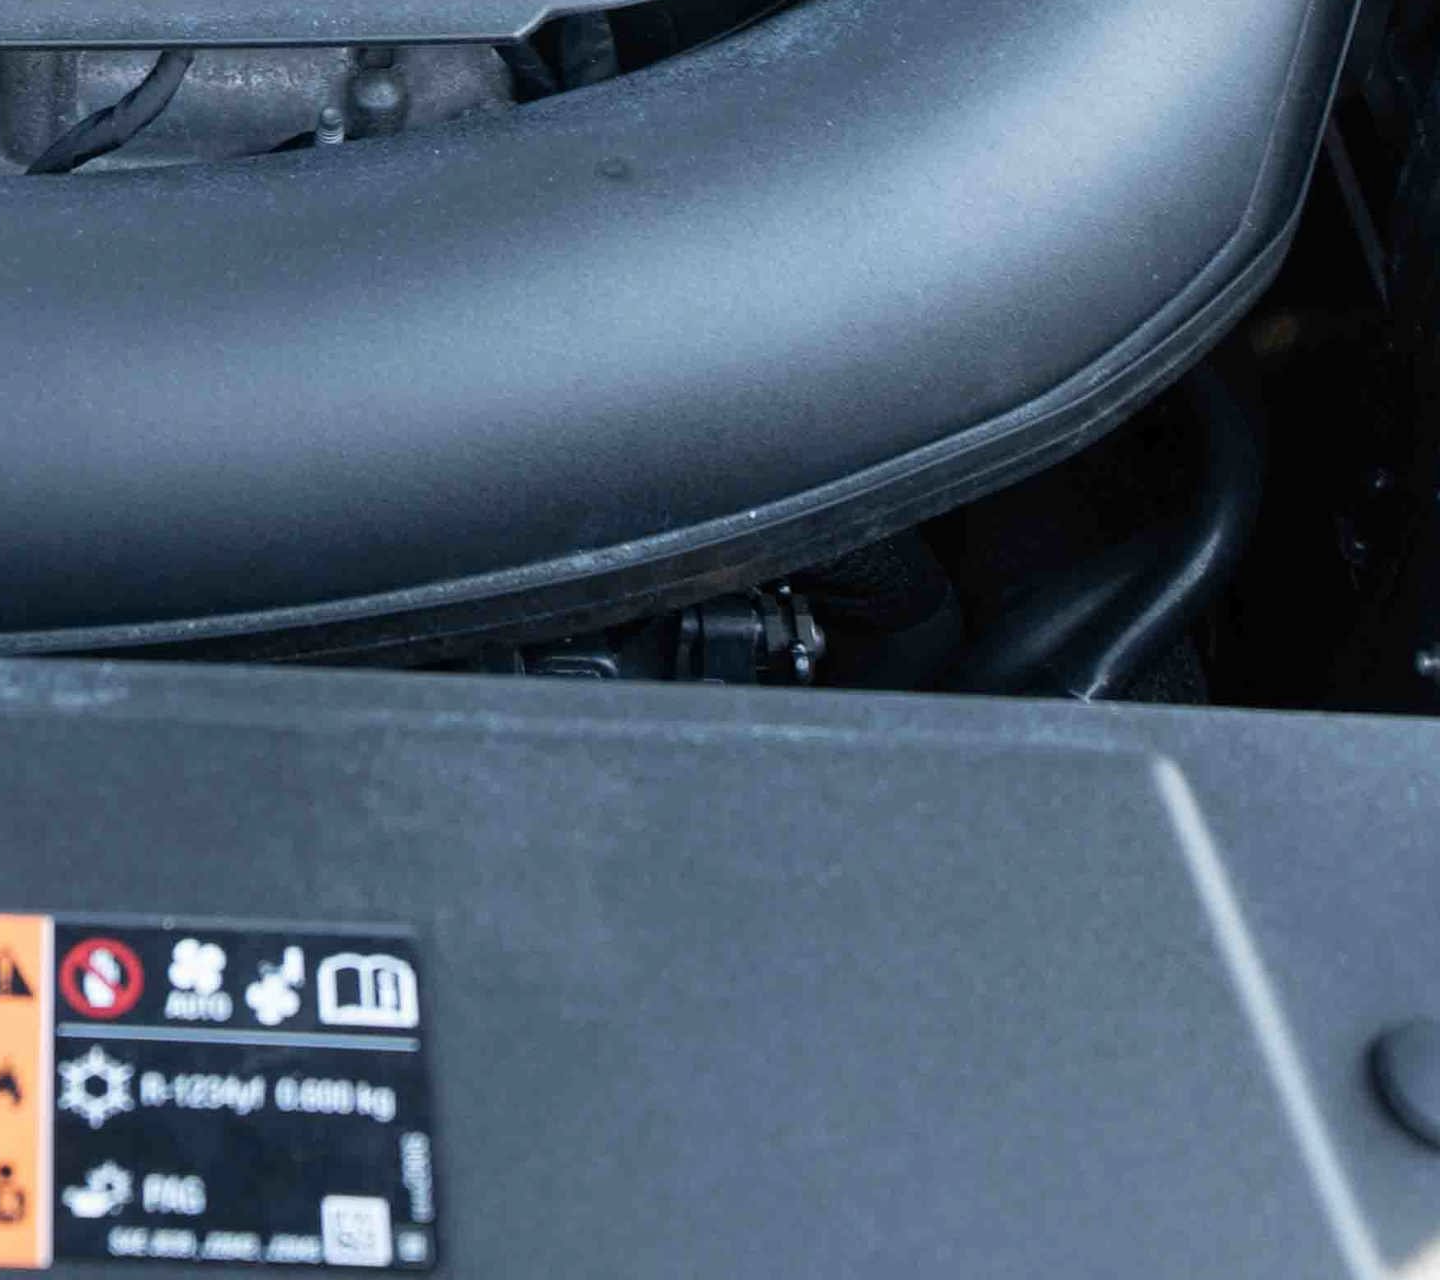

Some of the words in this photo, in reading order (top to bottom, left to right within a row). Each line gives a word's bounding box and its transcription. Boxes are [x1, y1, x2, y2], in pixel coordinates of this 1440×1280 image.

[165, 990, 232, 1021] AUTO
[140, 1071, 267, 1115] R-1234yf
[356, 1080, 397, 1123] kg
[142, 1172, 206, 1215] PAG
